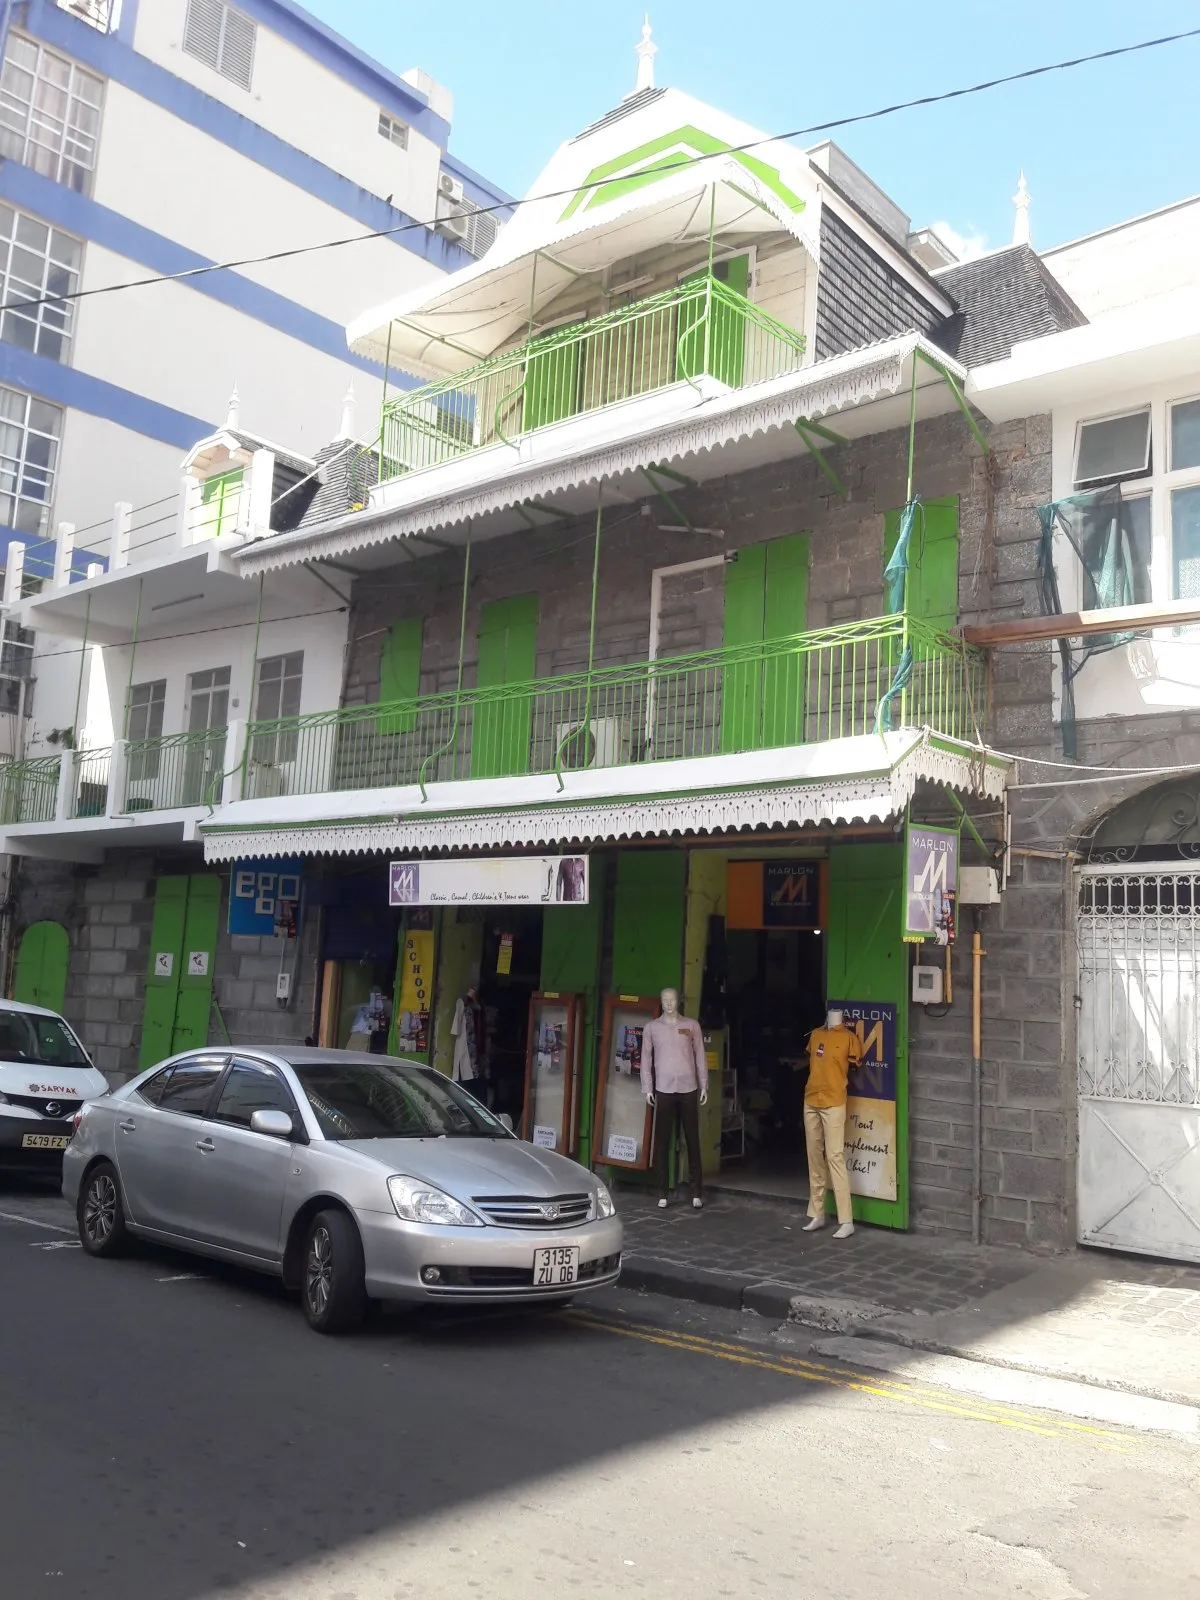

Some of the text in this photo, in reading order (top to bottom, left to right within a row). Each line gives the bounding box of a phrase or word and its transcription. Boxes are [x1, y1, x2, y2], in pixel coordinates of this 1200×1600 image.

[912, 837, 953, 851] MARLON
[391, 864, 417, 872] MARLON
[768, 866, 814, 876] MARLON
[235, 871, 300, 915] ego
[406, 939, 428, 1012] SCHOOL
[841, 1008, 892, 1021] ARLON
[865, 1060, 889, 1069] ABOVE
[26, 1135, 50, 1147] 5479
[51, 1136, 63, 1148] FZ
[543, 1248, 572, 1267] 3135
[538, 1265, 574, 1284] ZU 06
